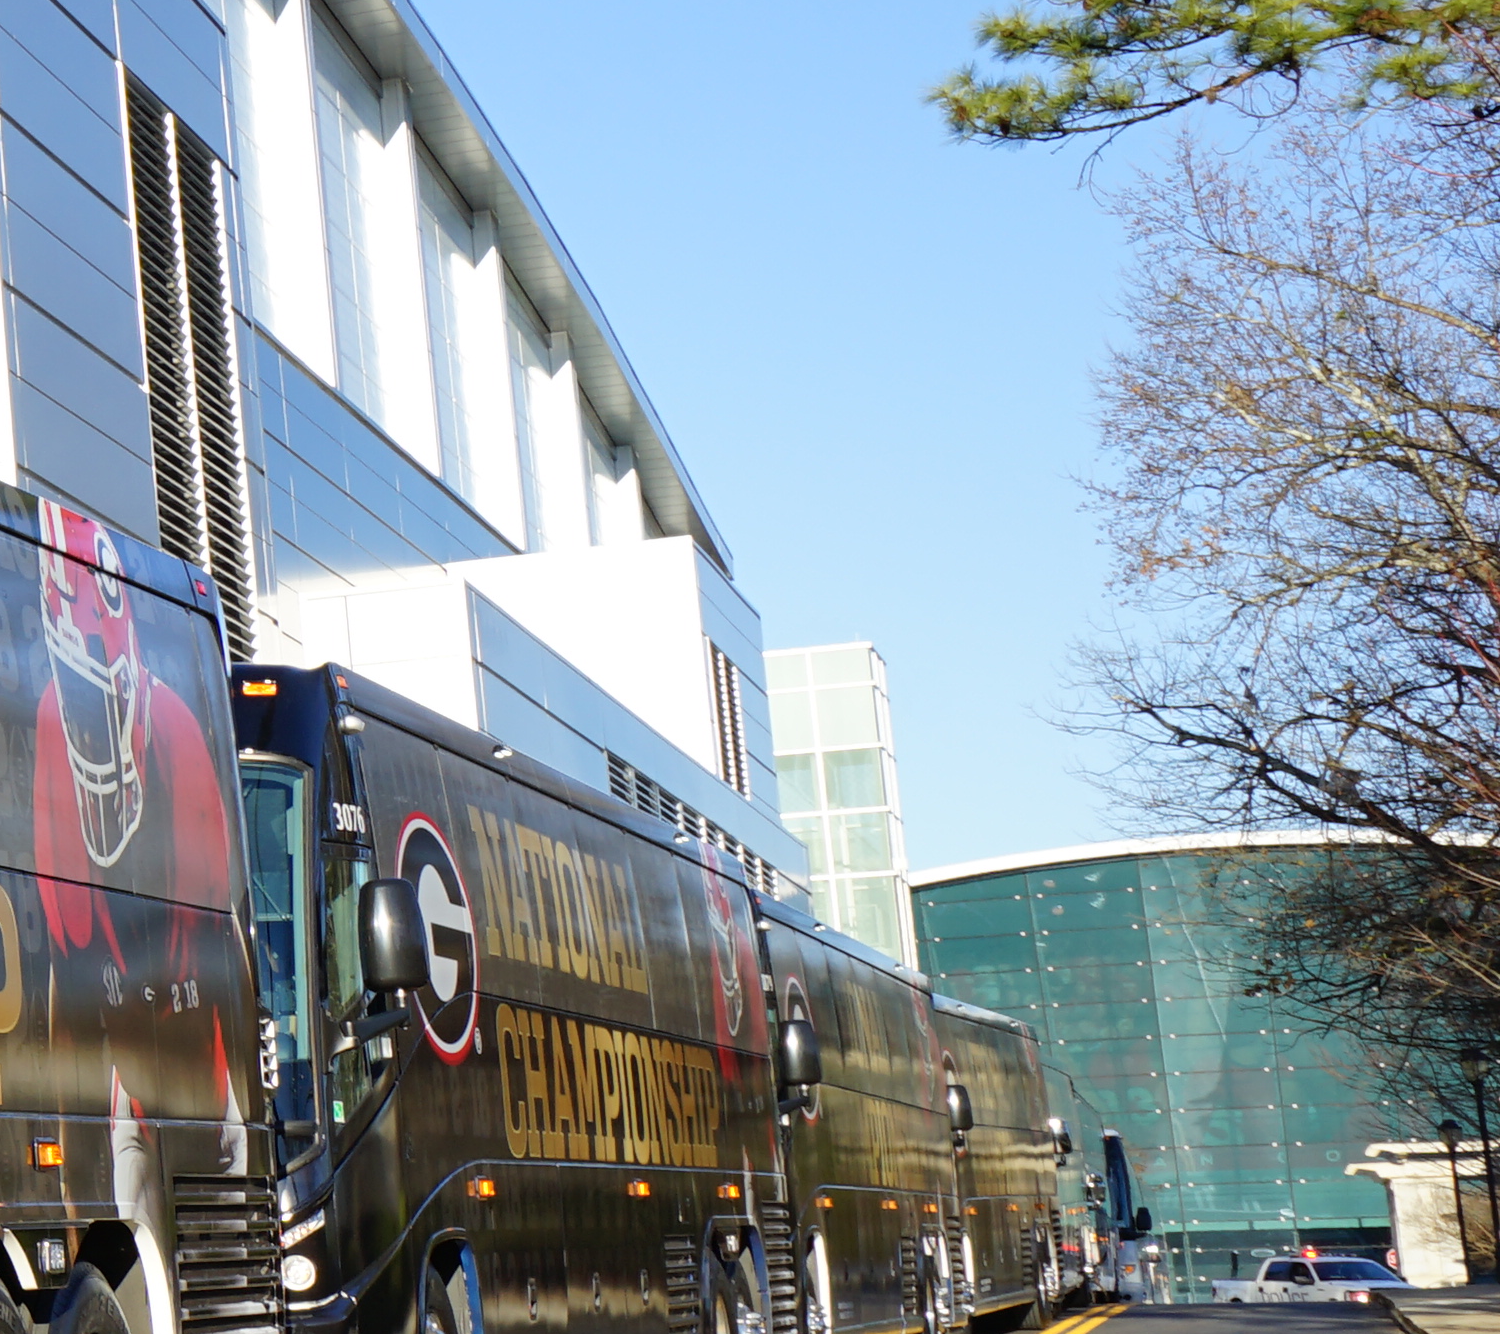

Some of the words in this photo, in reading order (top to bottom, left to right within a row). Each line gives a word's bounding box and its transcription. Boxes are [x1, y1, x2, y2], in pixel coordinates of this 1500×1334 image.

[332, 801, 366, 834] 3076
[466, 803, 649, 995] NATIONAL
[496, 1002, 721, 1168] CHAMPIONSHIP
